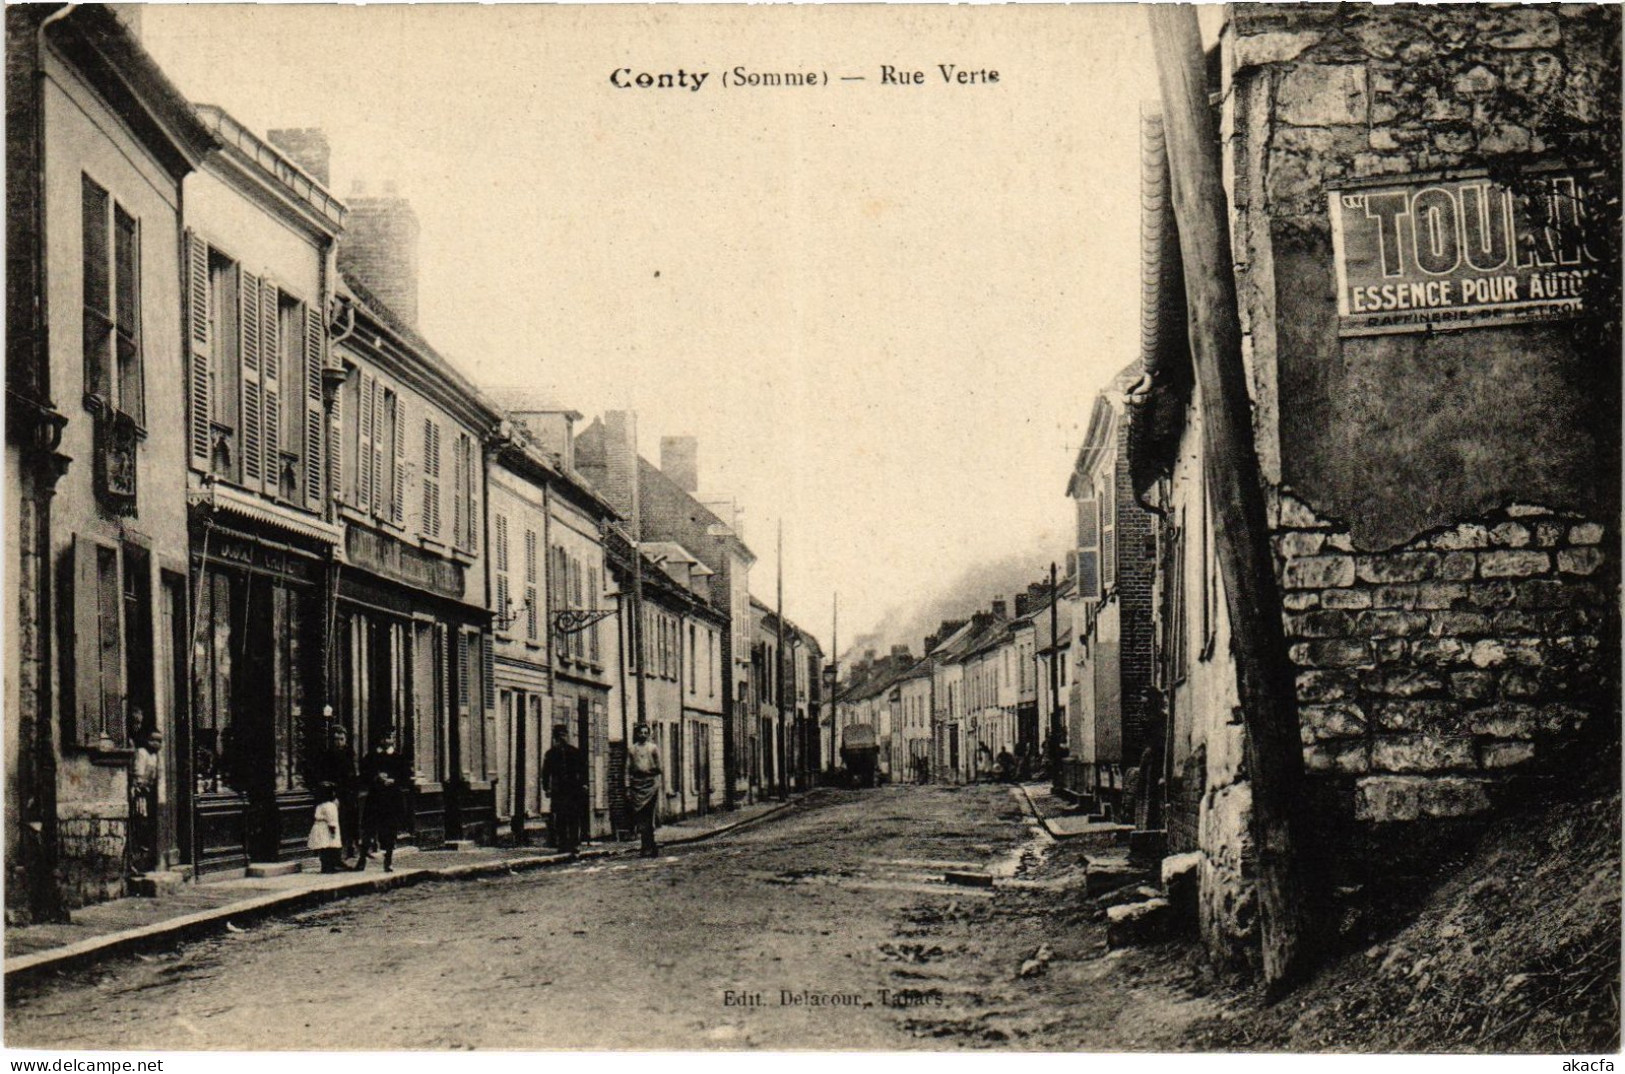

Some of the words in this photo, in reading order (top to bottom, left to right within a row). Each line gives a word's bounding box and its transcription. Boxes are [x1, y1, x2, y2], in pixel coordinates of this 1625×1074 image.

[1354, 282, 1451, 312] ESSENCE
[1461, 276, 1518, 303] POUR
[1530, 270, 1596, 299] AUTO
[1367, 311, 1469, 328] RAFFINERIE
